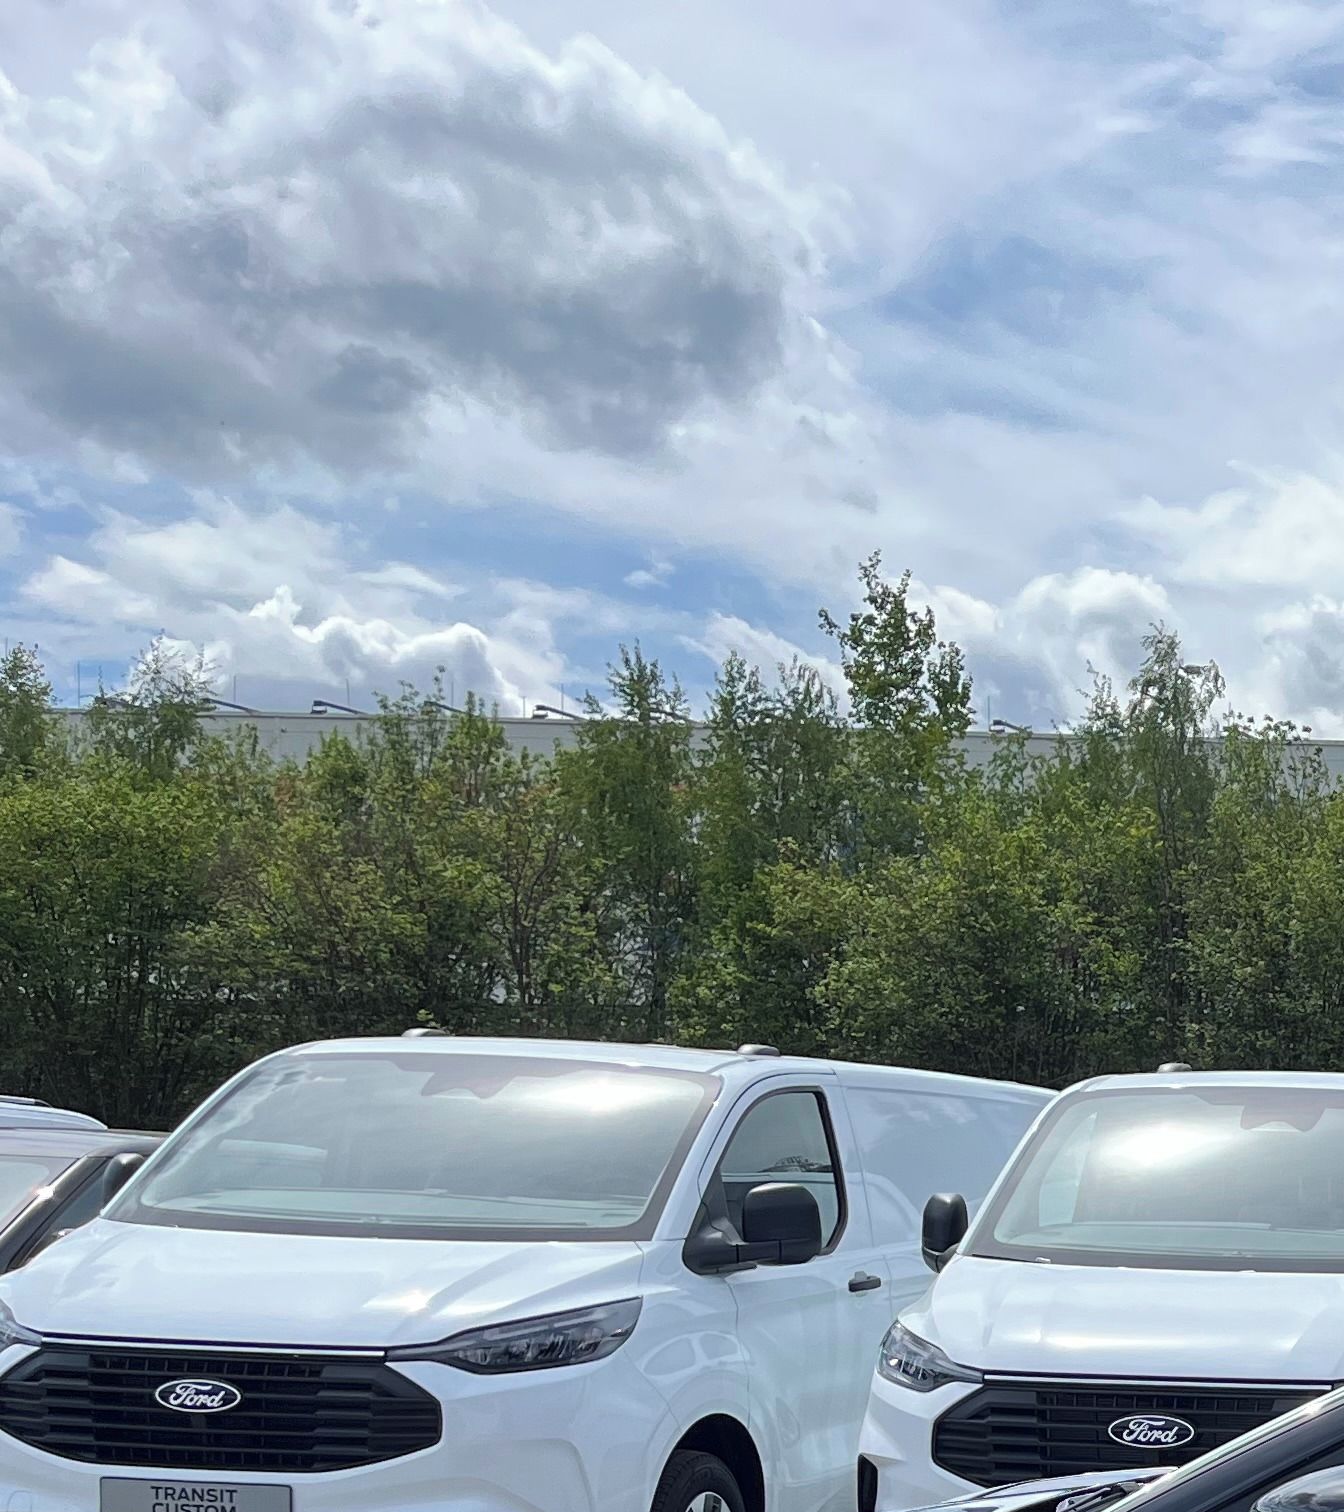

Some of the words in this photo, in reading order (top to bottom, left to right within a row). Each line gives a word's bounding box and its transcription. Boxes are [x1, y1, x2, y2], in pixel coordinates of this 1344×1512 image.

[168, 1383, 226, 1408] Ford
[1122, 1418, 1179, 1443] Ford
[151, 1485, 238, 1504] TRANSIT
